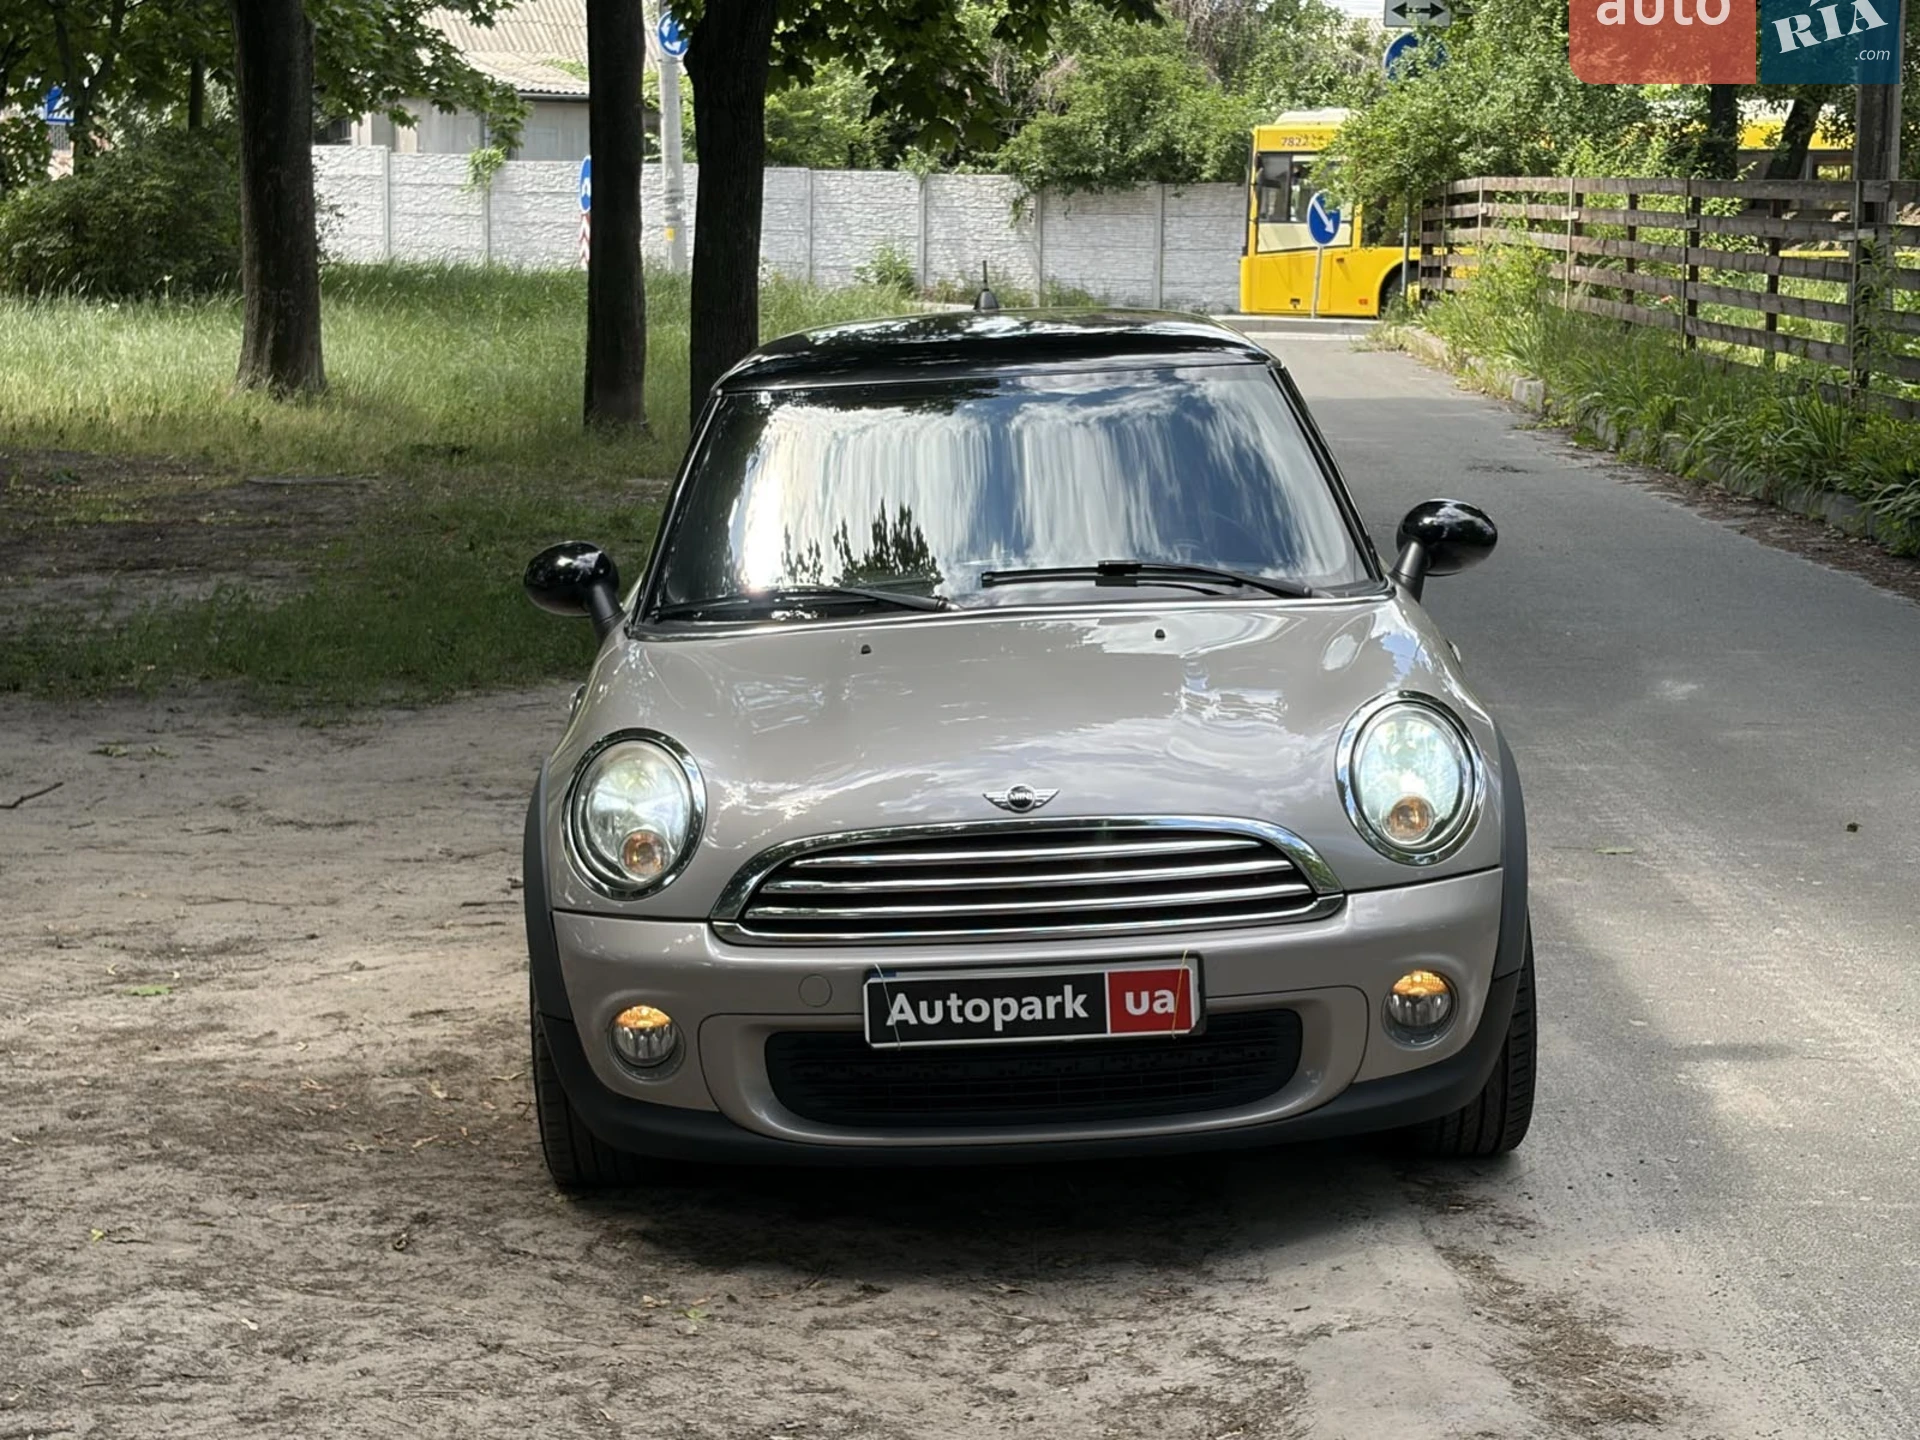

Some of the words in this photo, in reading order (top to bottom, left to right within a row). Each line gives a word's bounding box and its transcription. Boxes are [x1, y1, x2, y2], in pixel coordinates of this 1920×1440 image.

[1010, 791, 1033, 801] MINI
[886, 984, 1089, 1031] Autopark
[1124, 988, 1176, 1016] ua
